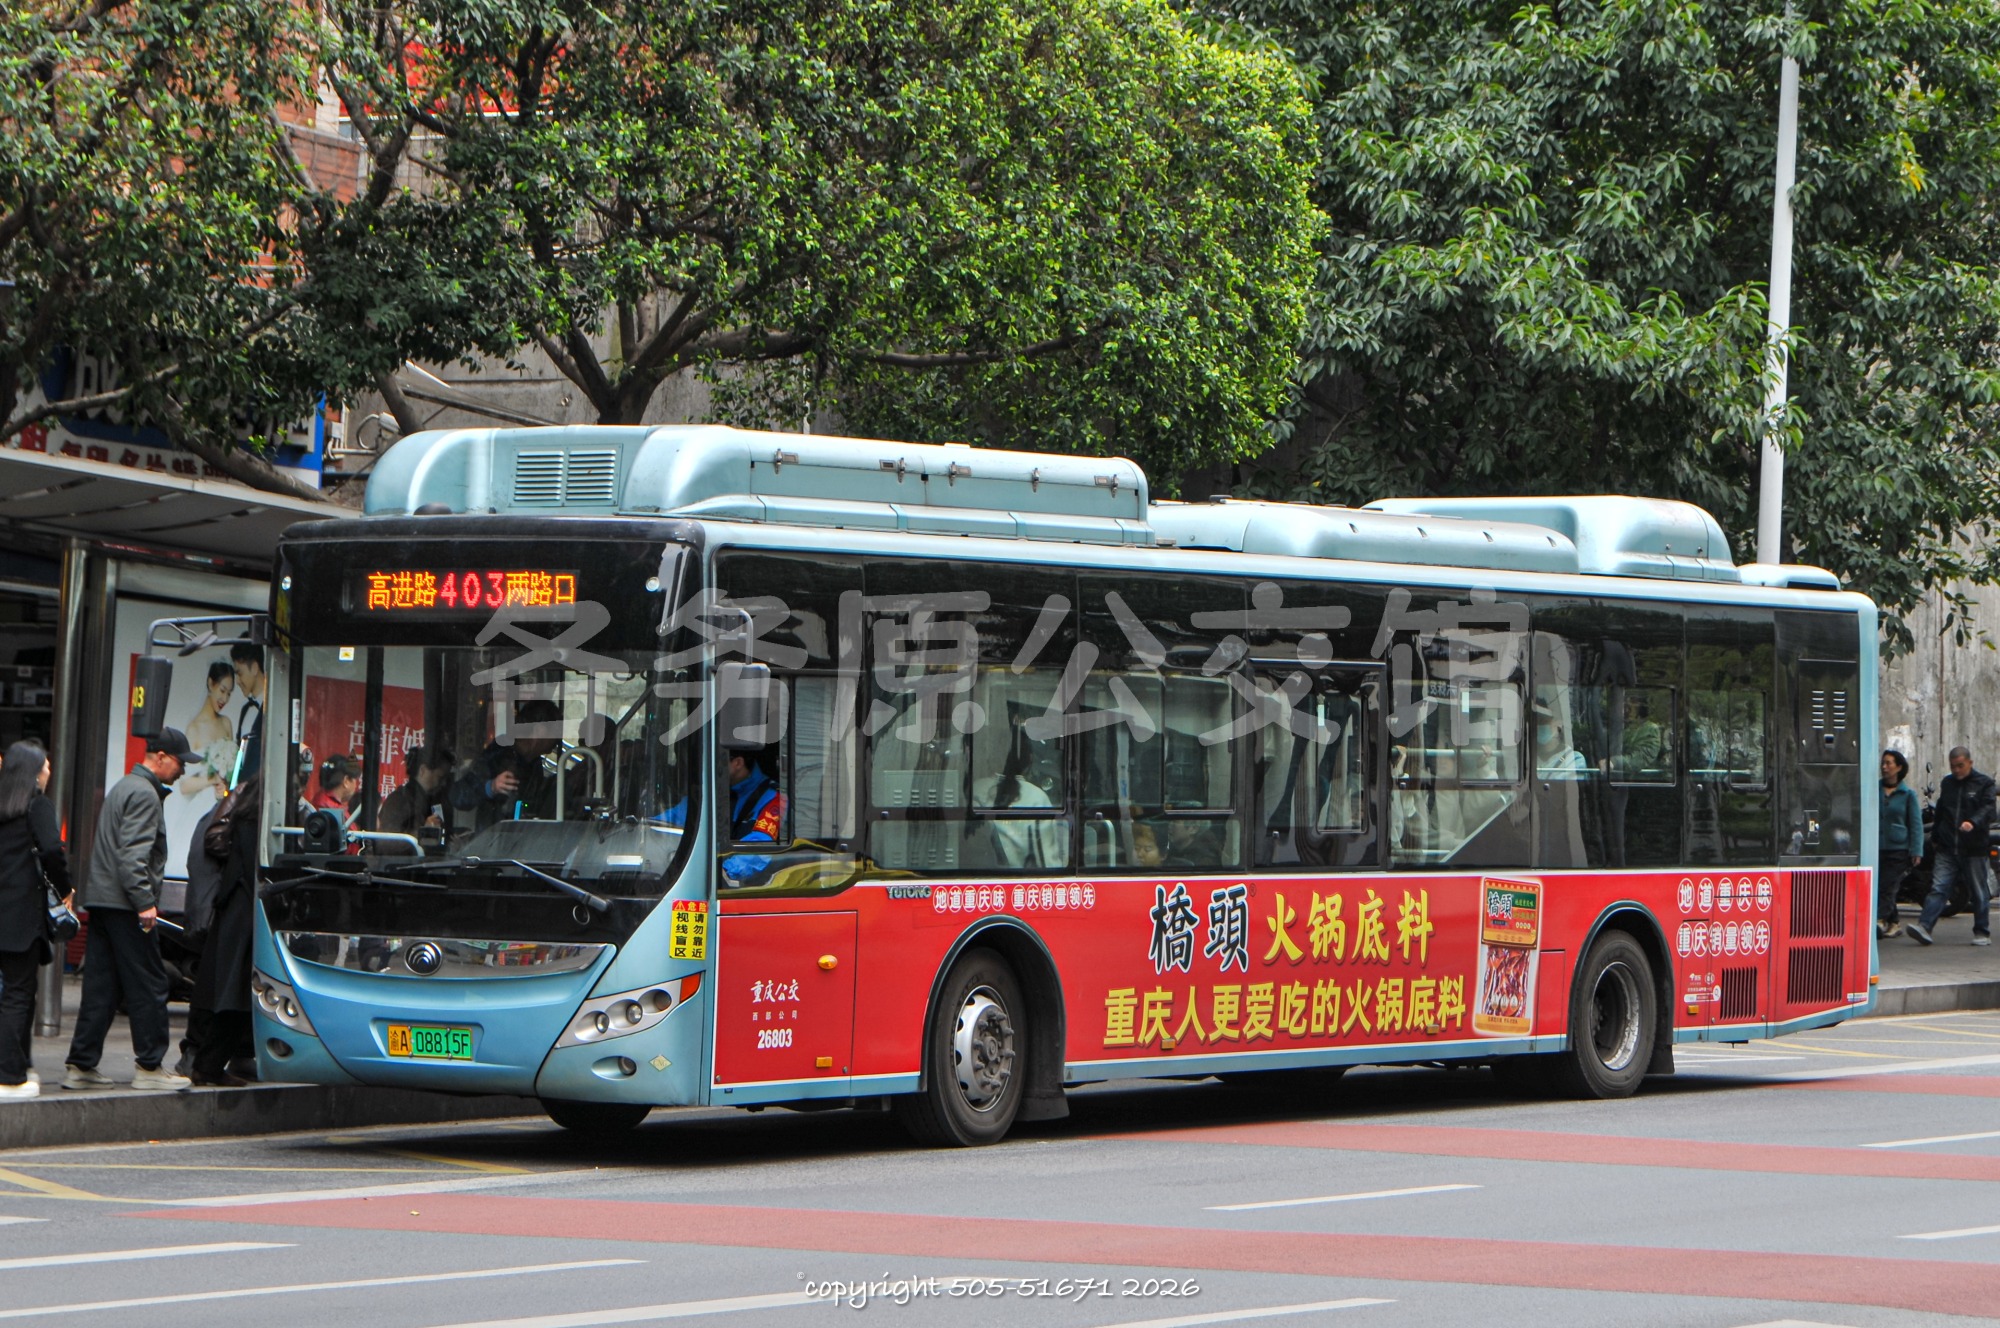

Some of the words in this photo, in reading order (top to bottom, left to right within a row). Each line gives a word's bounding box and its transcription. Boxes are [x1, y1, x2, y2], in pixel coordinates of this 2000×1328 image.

[368, 571, 437, 610] 高进路
[440, 572, 504, 608] 403
[506, 571, 575, 607] 两路口
[886, 885, 932, 899] YUTONG
[933, 886, 1005, 913] 地道重庆味
[1012, 883, 1095, 911] 重庆销量领先
[1678, 877, 1773, 913] 地道重庆味
[674, 912, 689, 957] 视线盲区
[692, 913, 705, 958] 请勿靠近
[1149, 882, 1249, 974] 橋頭
[1263, 889, 1434, 963] 火锅底料
[1677, 921, 1770, 957] 重庆销量领先
[750, 978, 800, 1003] 重庆公交
[1103, 975, 1466, 1045] 重庆人更爱吃的火锅底料
[757, 1028, 793, 1049] 26803
